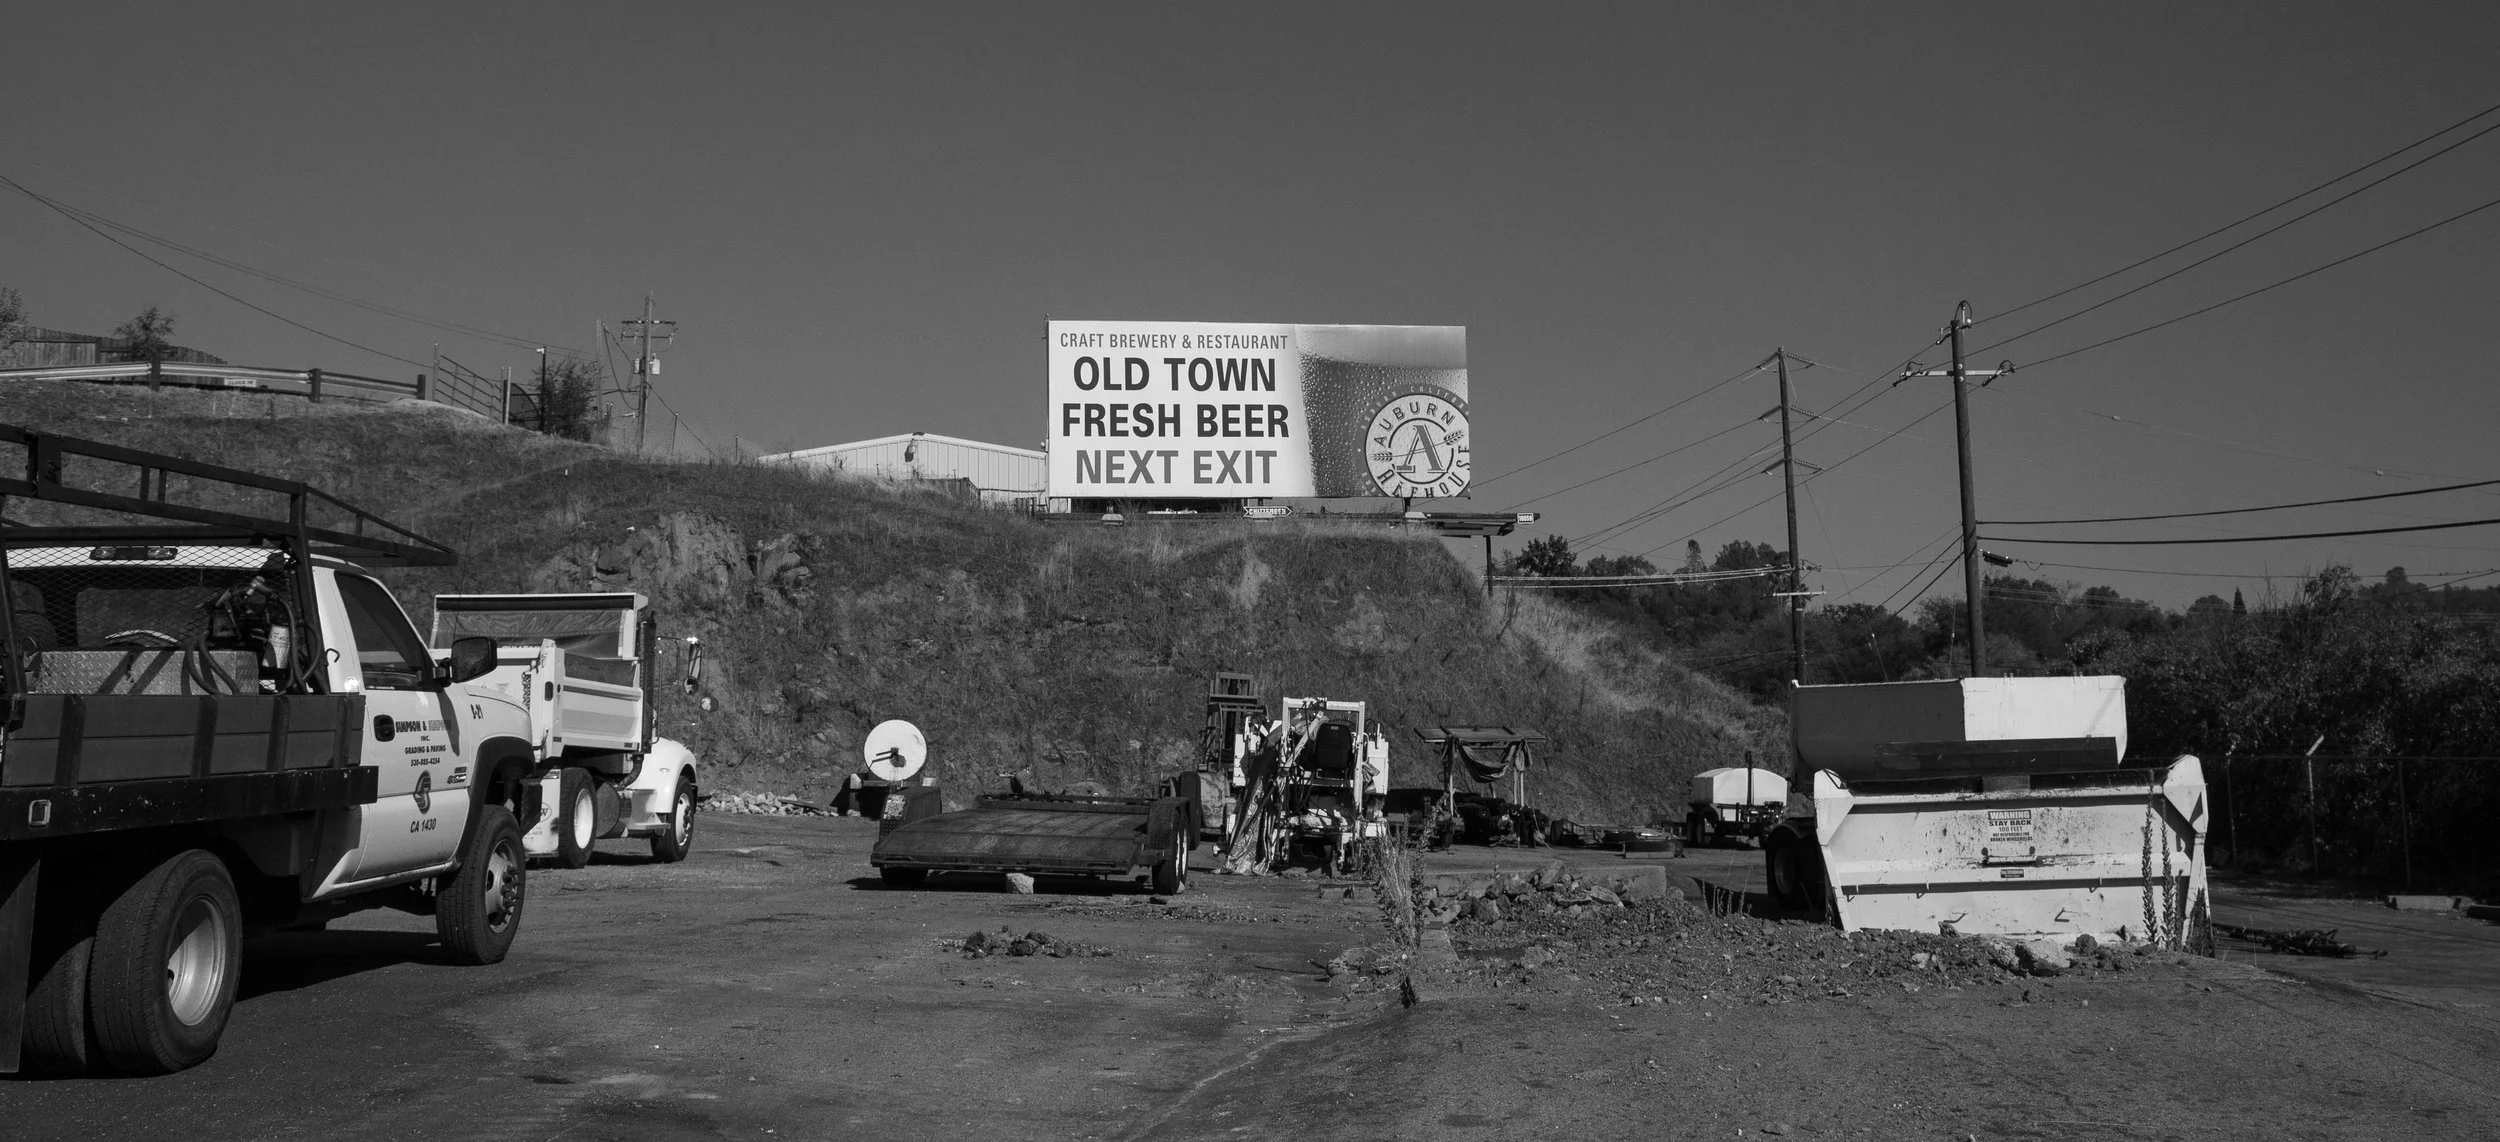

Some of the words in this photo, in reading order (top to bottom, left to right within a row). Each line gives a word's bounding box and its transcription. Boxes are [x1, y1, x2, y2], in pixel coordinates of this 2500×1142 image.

[1060, 333, 1104, 348] CRAFT
[1109, 334, 1176, 349] BREWERY
[1182, 335, 1192, 349] &
[1197, 335, 1288, 350] RESTAURANT
[1073, 356, 1150, 391] OLD
[1164, 357, 1276, 392] TOWN
[1063, 403, 1181, 438] FRESH
[1197, 404, 1289, 438] BEER
[1374, 401, 1456, 447] AUBURN
[1076, 450, 1179, 484] NEXT
[1193, 450, 1278, 484] EXIT
[1377, 445, 1471, 498] ALEHOUSE
[395, 721, 421, 732] SIMPSON
[405, 746, 425, 754] GRADING
[410, 820, 420, 833] CA
[421, 818, 437, 831] 1430
[1990, 811, 2030, 819] WARNING
